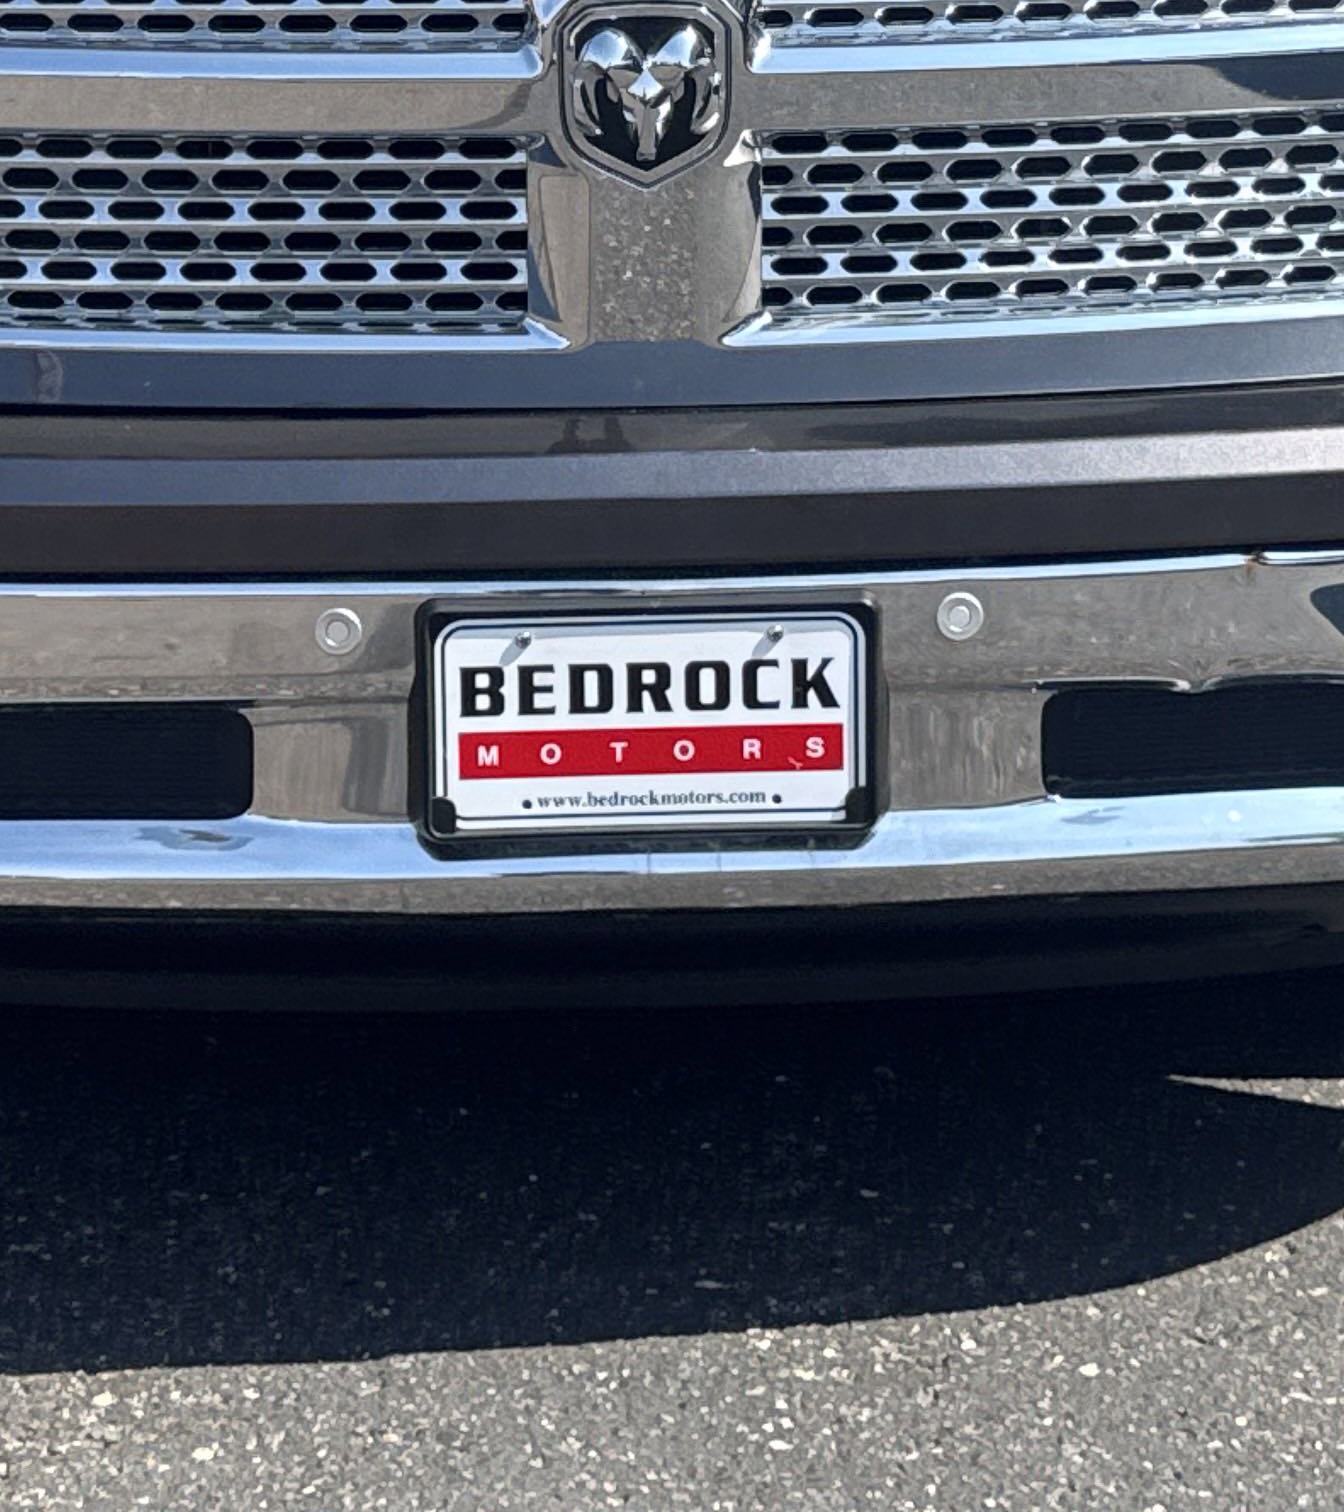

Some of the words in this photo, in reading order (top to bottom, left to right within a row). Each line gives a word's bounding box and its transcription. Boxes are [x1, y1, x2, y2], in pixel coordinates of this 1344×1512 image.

[459, 657, 840, 717] BEDROCK
[477, 736, 825, 767] MOTORS
[537, 790, 766, 809] www.bedrockmotors.com
